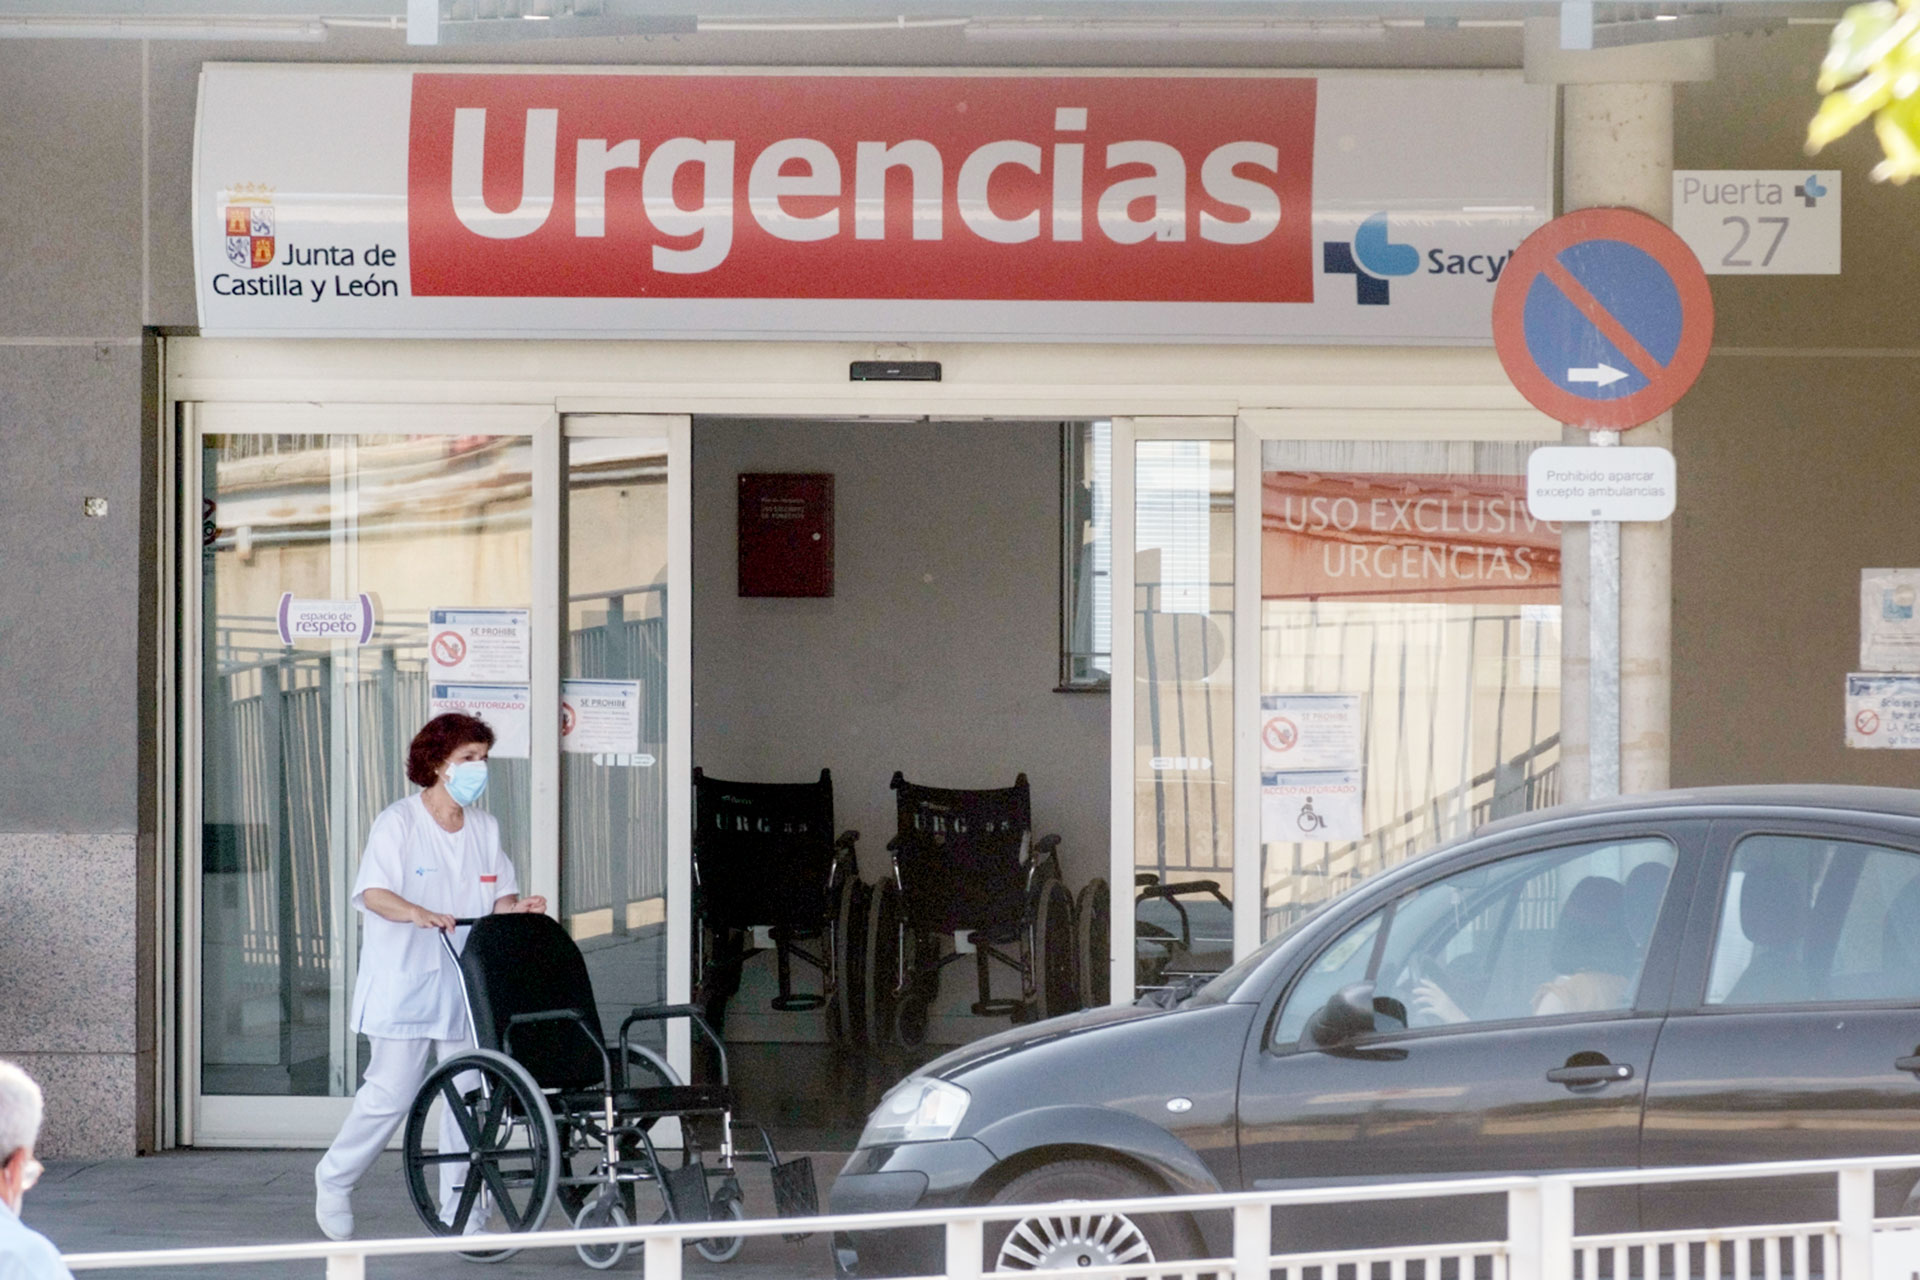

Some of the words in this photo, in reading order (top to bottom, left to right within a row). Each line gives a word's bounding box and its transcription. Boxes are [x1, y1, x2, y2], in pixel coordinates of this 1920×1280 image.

[451, 107, 1282, 274] Urgencias
[1683, 177, 1783, 206] Puerta
[1721, 216, 1790, 267] 27
[282, 244, 354, 267] Junta
[364, 244, 397, 267] de
[212, 273, 303, 296] Castilla
[310, 280, 327, 303] y
[335, 273, 399, 297] León
[1546, 470, 1605, 482] Prohibido
[1608, 471, 1655, 483] aparcar
[1536, 486, 1585, 499] excepto
[1587, 486, 1666, 497] ambulancias
[1284, 496, 1359, 532] USO
[1323, 543, 1533, 581] URGENCIAS
[300, 612, 337, 622] espacio
[339, 611, 353, 621] de
[295, 620, 357, 637] respeto
[432, 700, 466, 709] ACCESO
[468, 700, 526, 710] AUTORIZADO
[1262, 786, 1297, 795] ACCESO
[1298, 785, 1358, 795] AUTORIZADO
